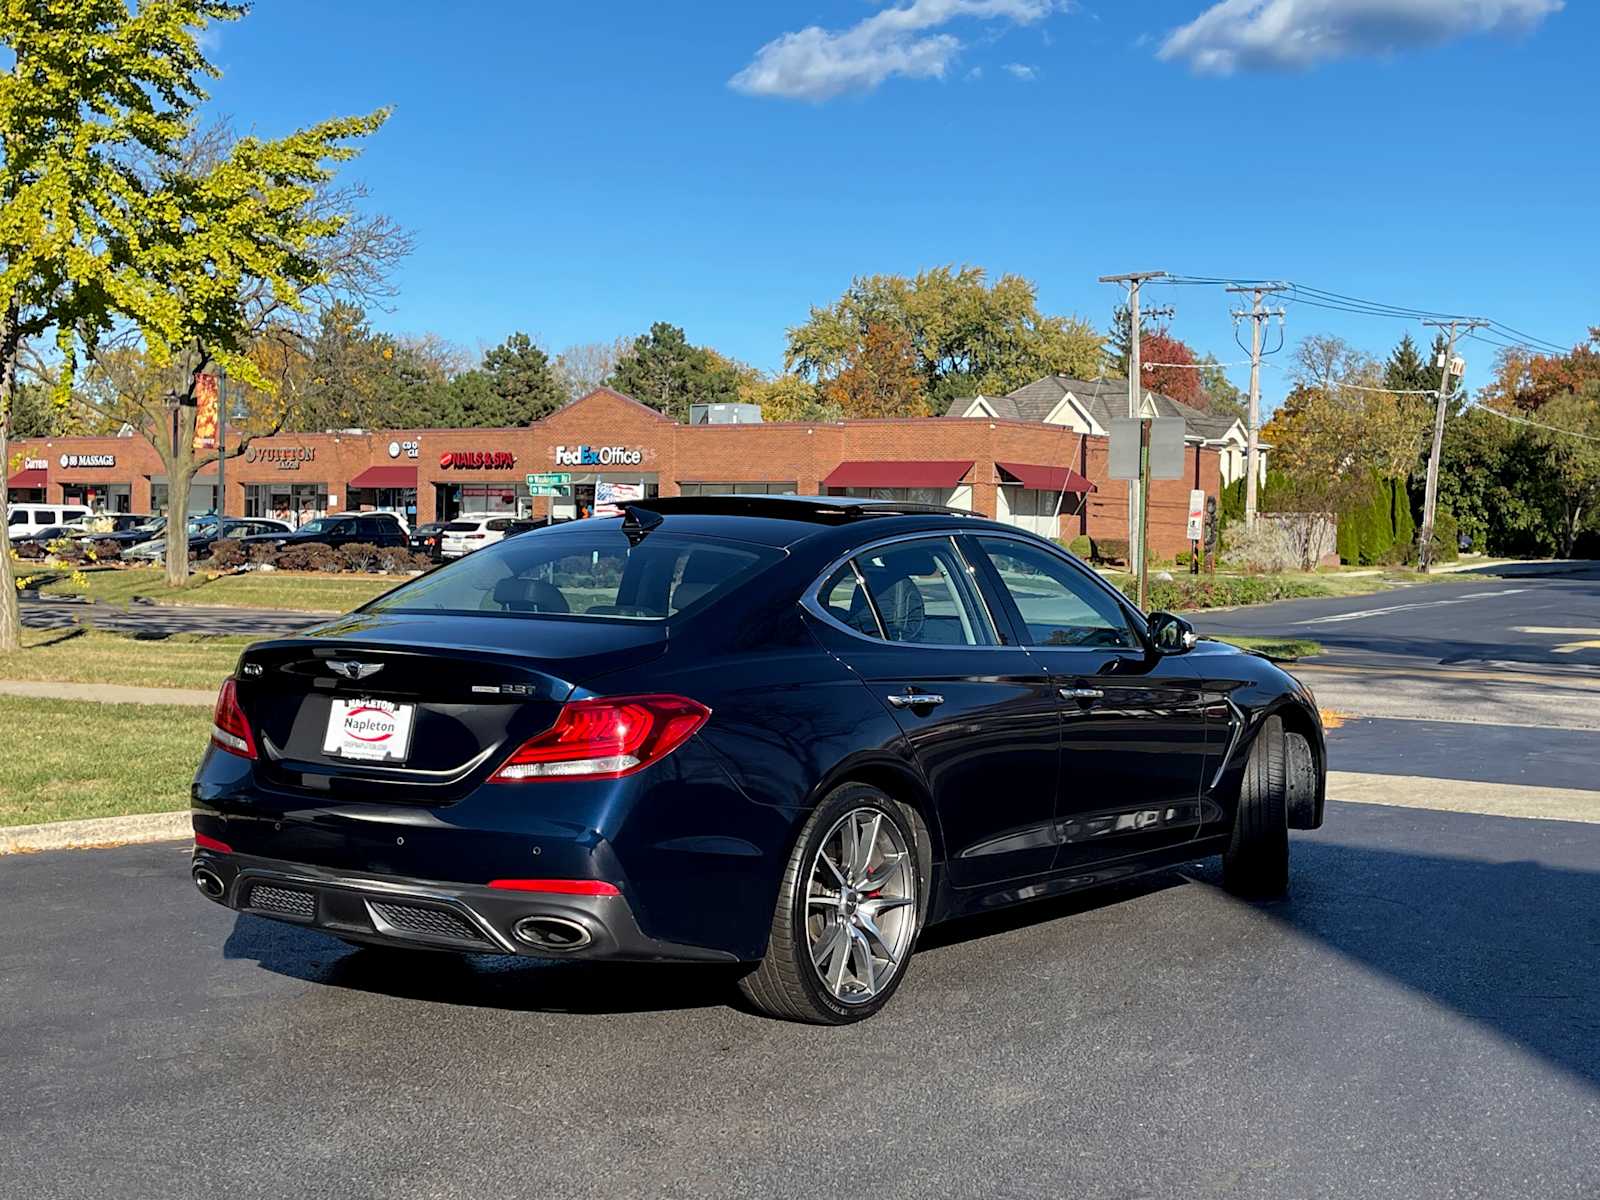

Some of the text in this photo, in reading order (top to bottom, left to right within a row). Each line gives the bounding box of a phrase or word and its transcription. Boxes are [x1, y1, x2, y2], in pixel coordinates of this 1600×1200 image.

[79, 455, 114, 466] MASSAGE
[452, 452, 482, 466] NAILS
[493, 452, 514, 466] SPA
[555, 446, 641, 464] FedEx Office
[348, 699, 395, 714] NAPLETON
[344, 718, 395, 732] Napleton
